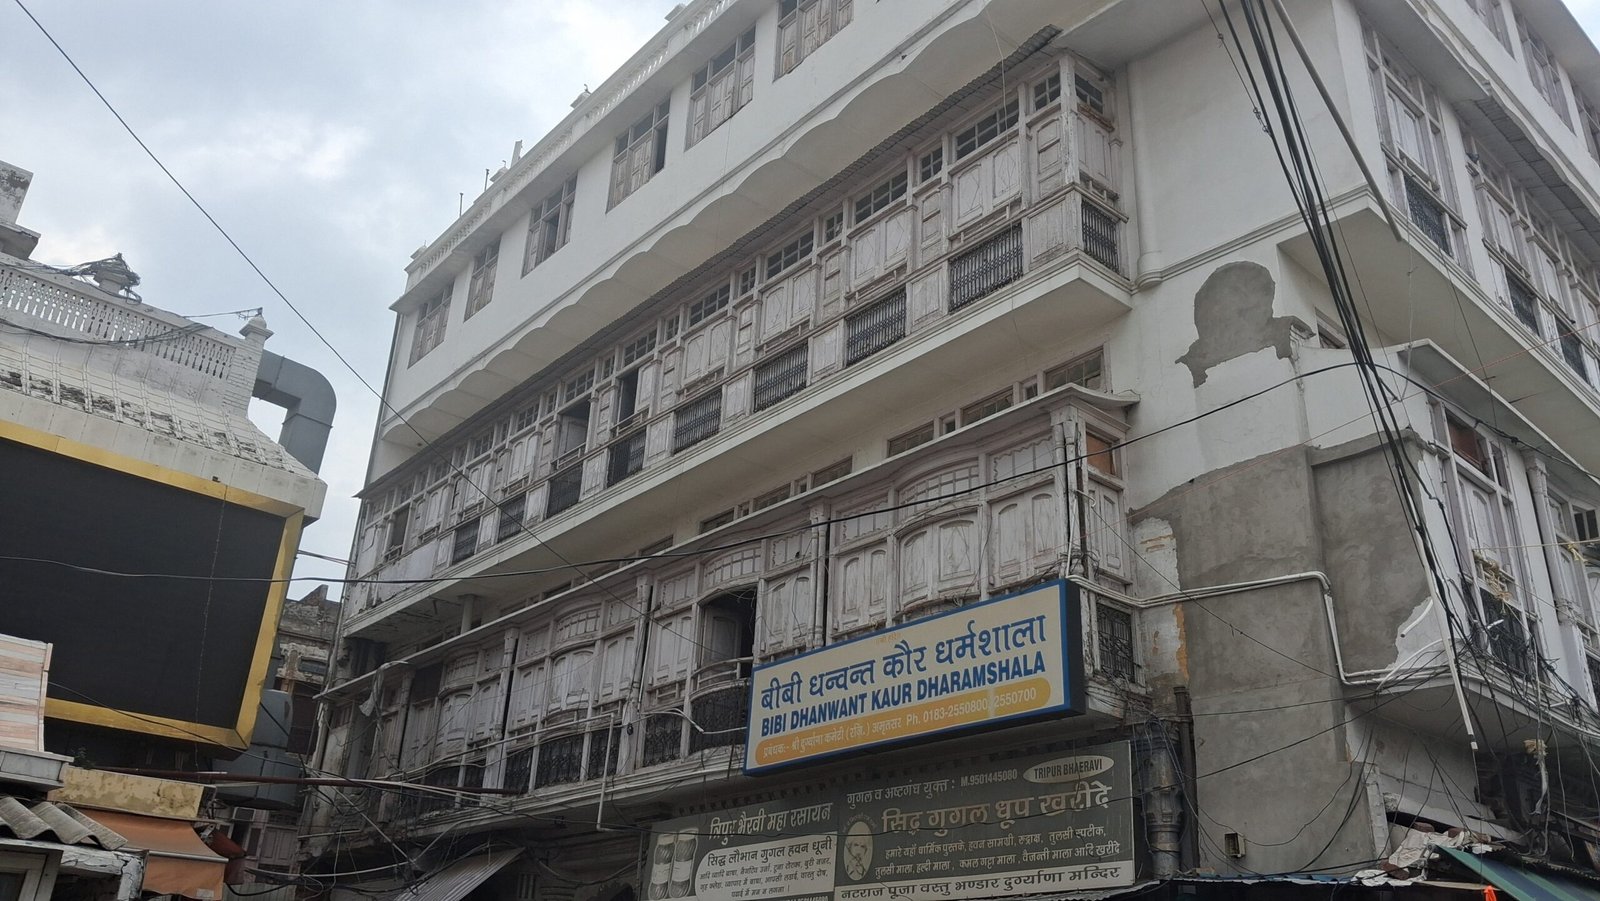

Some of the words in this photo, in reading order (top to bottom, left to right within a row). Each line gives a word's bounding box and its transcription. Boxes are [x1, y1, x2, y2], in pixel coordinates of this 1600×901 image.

[761, 671, 802, 710] बीबी
[809, 659, 875, 697] धन्वन्त
[883, 640, 926, 678] कौर
[936, 615, 1047, 664] धर्मशाला
[761, 712, 787, 737] BIBI
[791, 692, 867, 730] DHANWANT
[871, 686, 912, 711] KAUR
[917, 651, 1045, 700] DHARAMSHALA
[792, 736, 800, 751] श्री
[824, 726, 844, 744] कमेटी
[872, 717, 902, 735] अमृतसर
[906, 713, 921, 727] Ph.
[994, 687, 1037, 708] 2550700
[1034, 765, 1062, 779] TRIPUR
[1063, 758, 1103, 775] BHAERAVI
[847, 790, 873, 809] गुगल
[874, 789, 883, 801] व
[960, 768, 1018, 787] M.9501445080
[738, 808, 766, 835] भैरवी
[767, 810, 789, 832] महा
[790, 803, 833, 828] रसायन
[926, 803, 991, 837] गुगल
[995, 797, 1034, 829] धूप
[708, 853, 726, 867] सिद्ध
[728, 848, 758, 864] लौभान
[761, 846, 785, 863] गुगल
[788, 843, 809, 857] हवन
[811, 835, 832, 855] धूनी
[875, 863, 895, 880] तुलसी
[960, 858, 980, 869] कमल
[1051, 848, 1073, 860] माला
[1074, 843, 1095, 857] आदि
[885, 846, 903, 860] हमारे
[968, 838, 986, 852] हवन
[1048, 826, 1074, 846] तुलसी
[841, 887, 885, 899] नटराज
[888, 885, 917, 899] पूजा
[920, 882, 952, 896] वस्तु
[955, 878, 999, 891] भण्डार
[1068, 865, 1121, 881] मन्दिर
